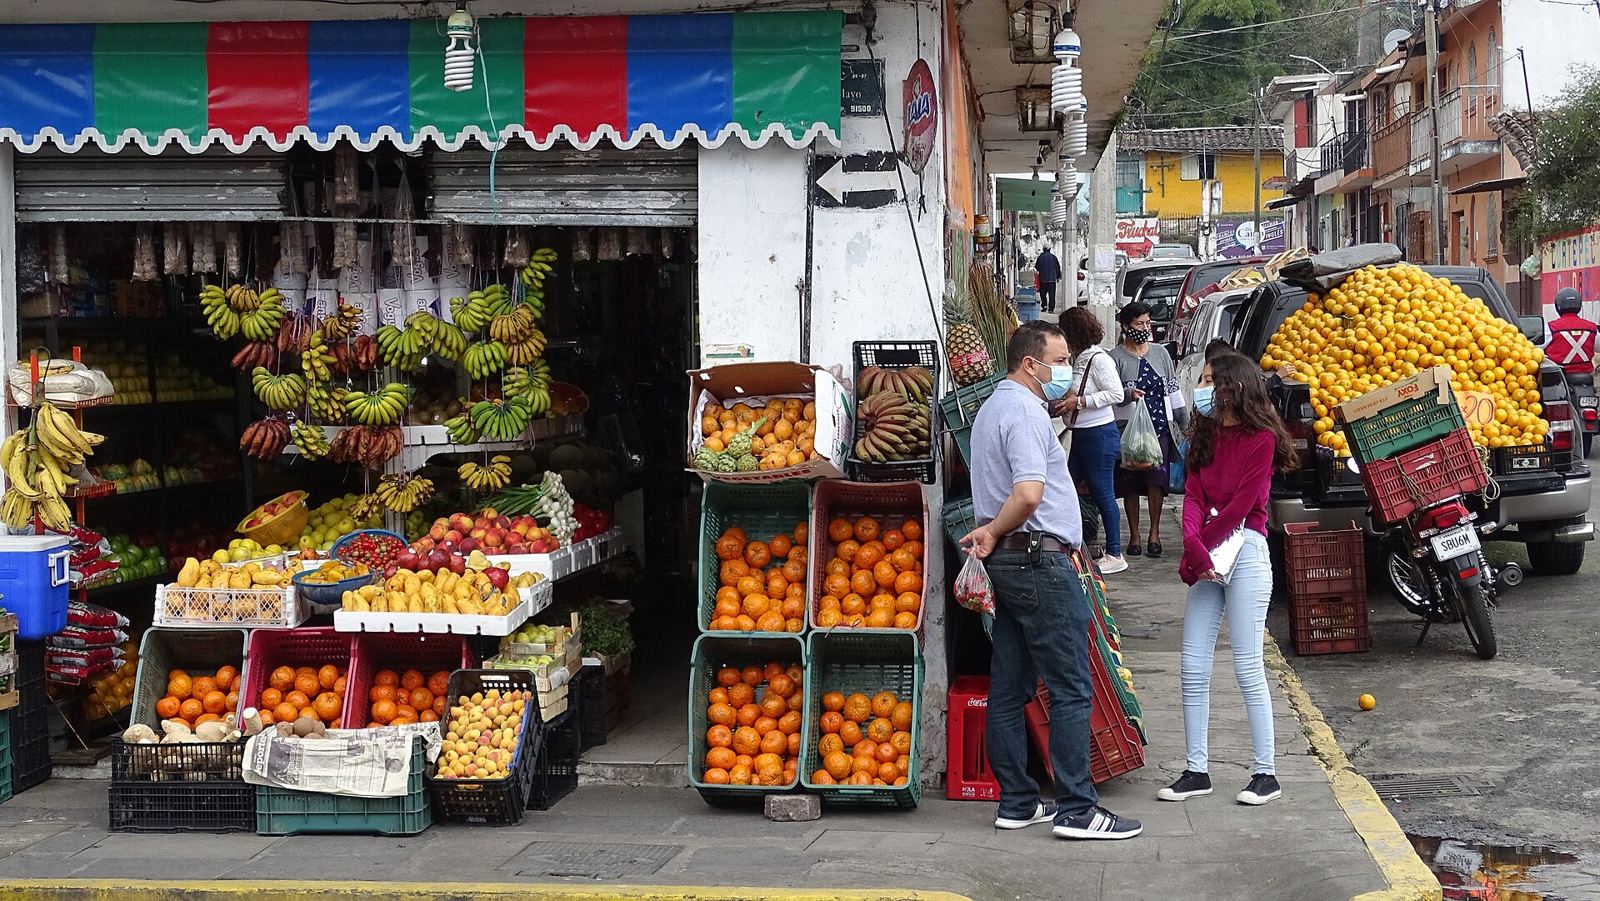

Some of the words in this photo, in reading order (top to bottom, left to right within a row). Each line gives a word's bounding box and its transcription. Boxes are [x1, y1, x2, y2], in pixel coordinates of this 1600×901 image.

[850, 105, 871, 113] 91500
[907, 92, 931, 127] LALA
[352, 303, 366, 337] Voge
[384, 297, 402, 326] Vogu
[1397, 383, 1419, 398] FOXY
[1441, 533, 1471, 552] SBU6M
